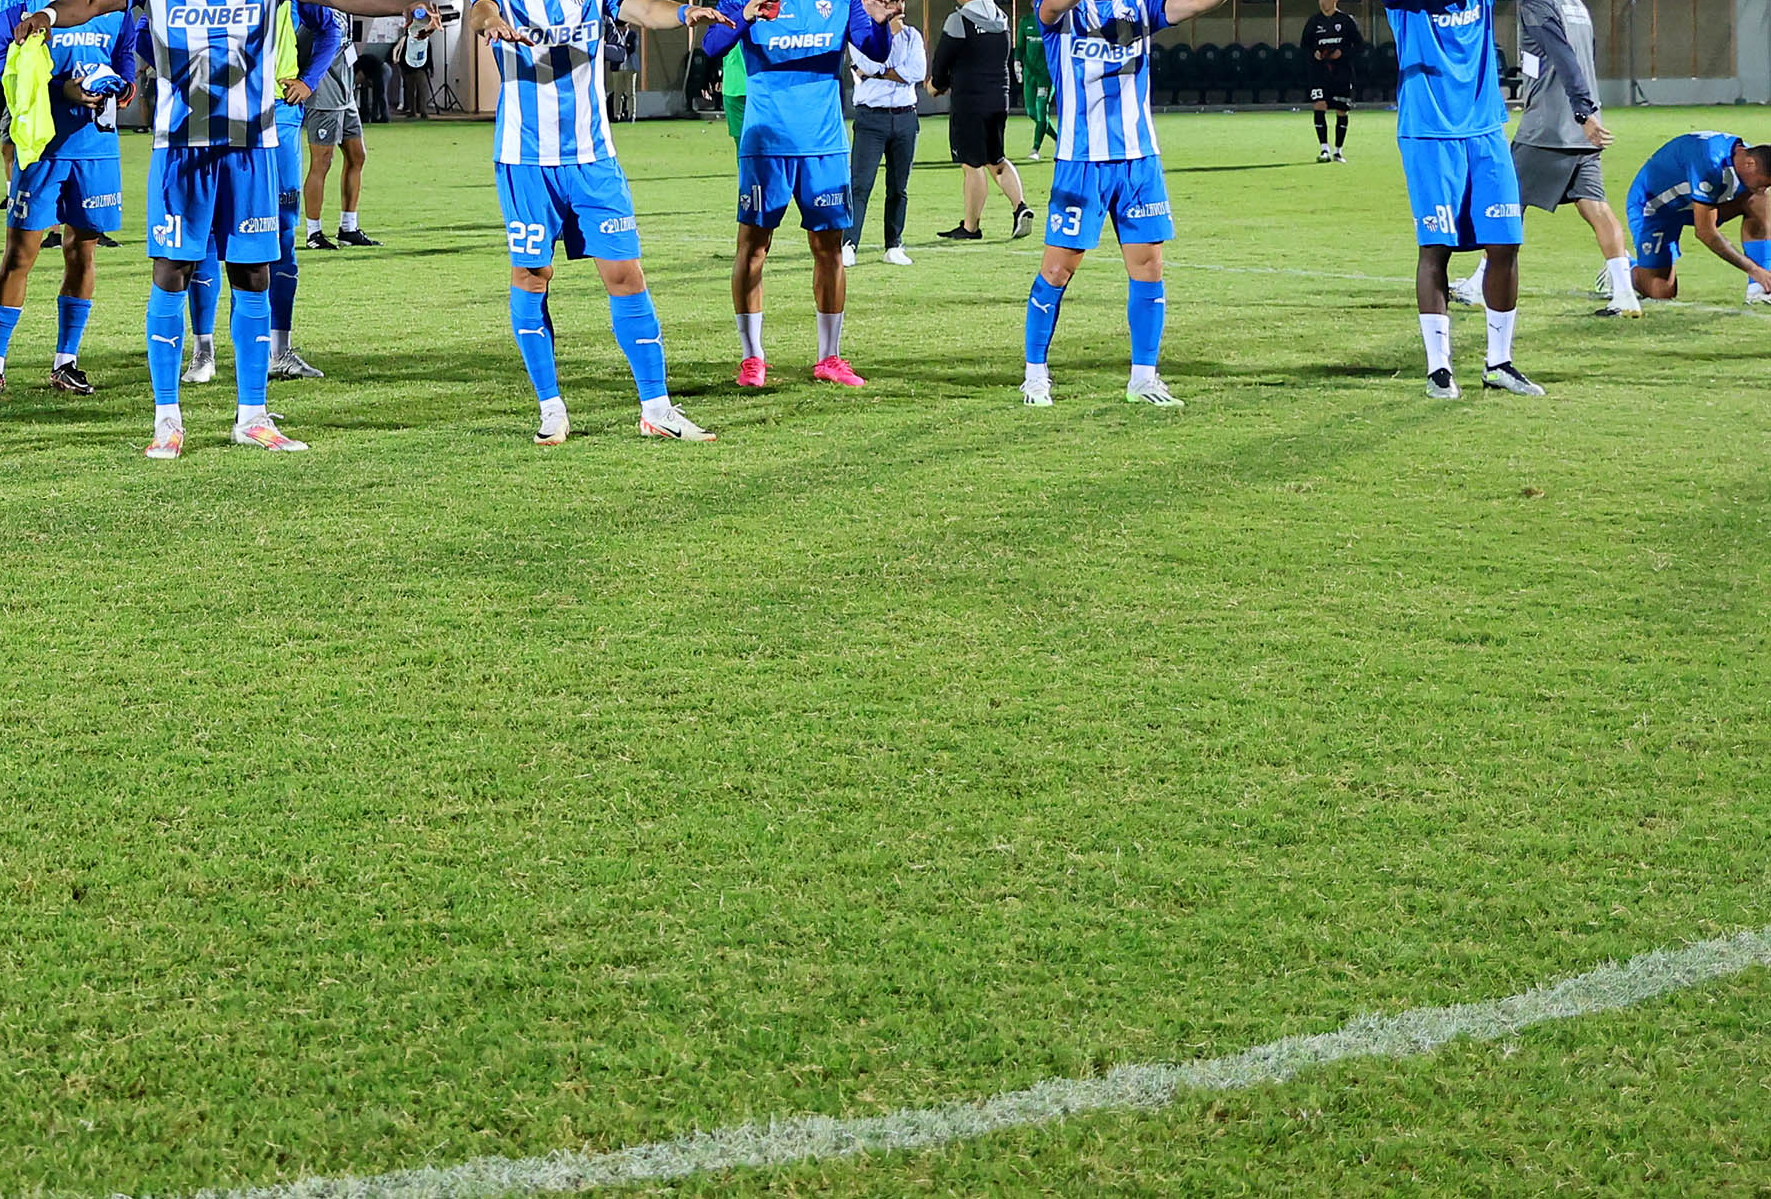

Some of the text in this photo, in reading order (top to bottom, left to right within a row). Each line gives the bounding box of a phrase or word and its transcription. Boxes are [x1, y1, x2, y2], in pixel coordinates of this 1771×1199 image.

[170, 6, 259, 25] FONBET
[52, 32, 111, 49] FONBET
[768, 33, 834, 51] FONBET
[1062, 206, 1082, 236] 3
[1435, 204, 1457, 234] 81
[508, 220, 545, 255] 22
[1652, 232, 1664, 254] 7
